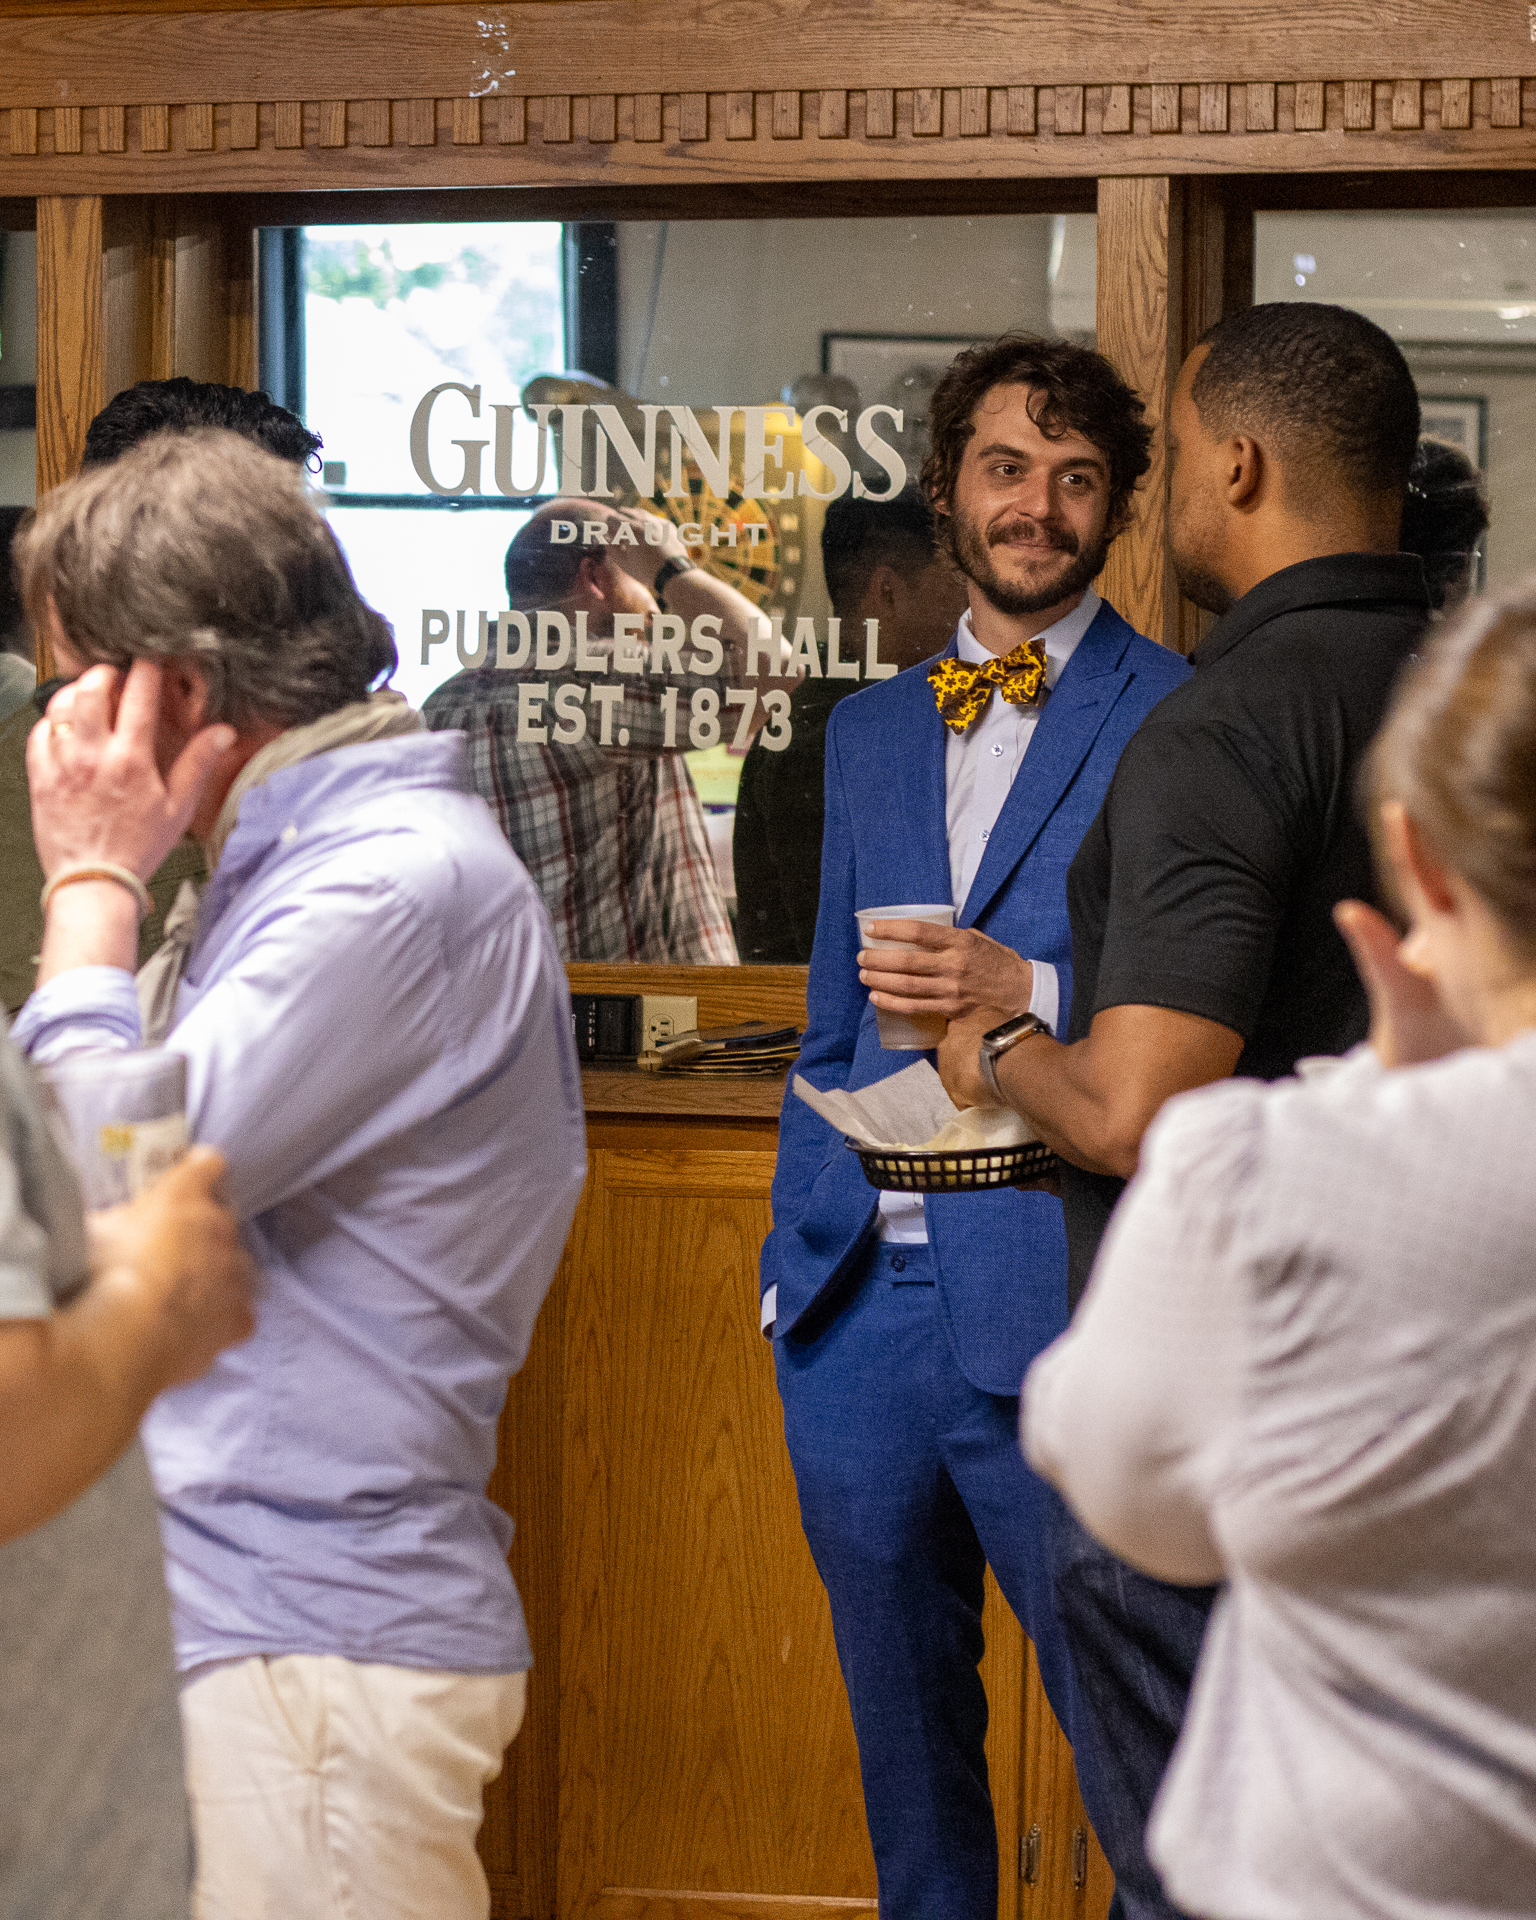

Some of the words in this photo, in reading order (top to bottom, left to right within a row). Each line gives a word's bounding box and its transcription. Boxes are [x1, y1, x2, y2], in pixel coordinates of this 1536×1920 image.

[409, 382, 908, 502] GUINNESS
[549, 520, 768, 547] DRAUGHT
[420, 609, 724, 676] PUDDLERS
[745, 616, 899, 681] HALL
[516, 682, 631, 746] EST.
[661, 687, 793, 752] 1873
